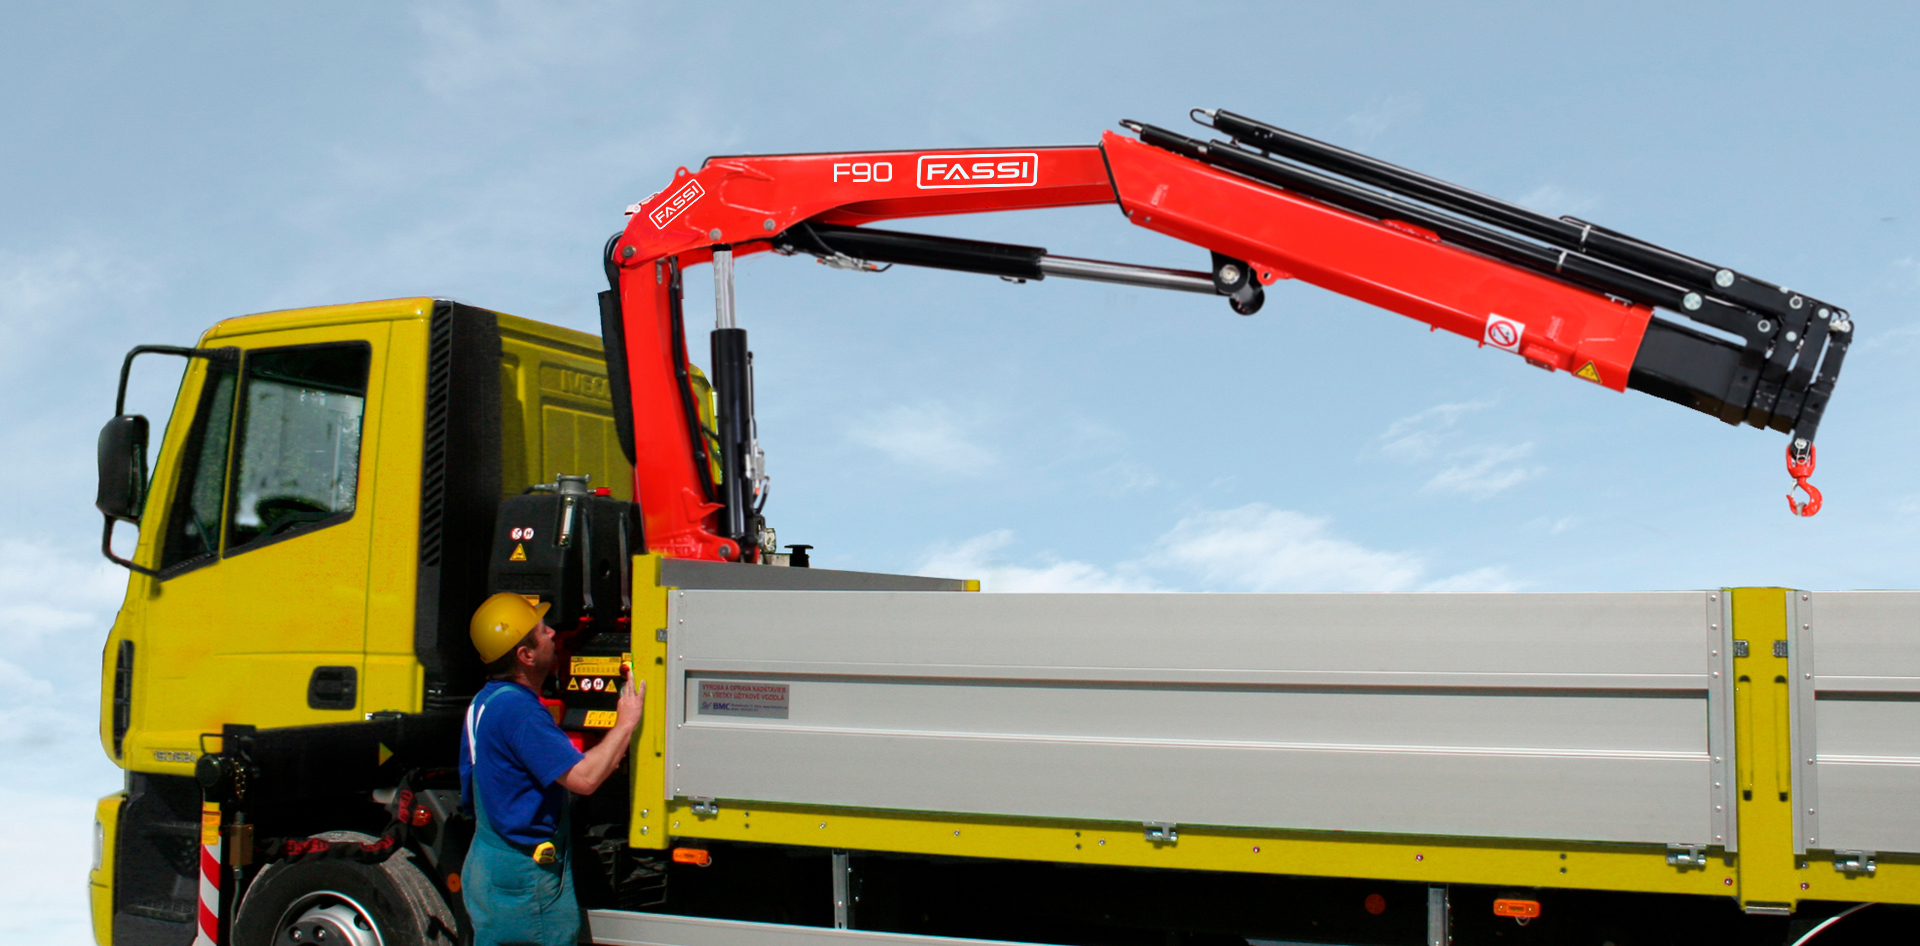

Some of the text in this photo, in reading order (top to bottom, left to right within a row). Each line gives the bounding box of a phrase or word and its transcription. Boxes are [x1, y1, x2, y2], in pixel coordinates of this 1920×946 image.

[833, 162, 893, 183] F90
[926, 161, 1029, 181] FASSI
[653, 185, 701, 224] FASSI
